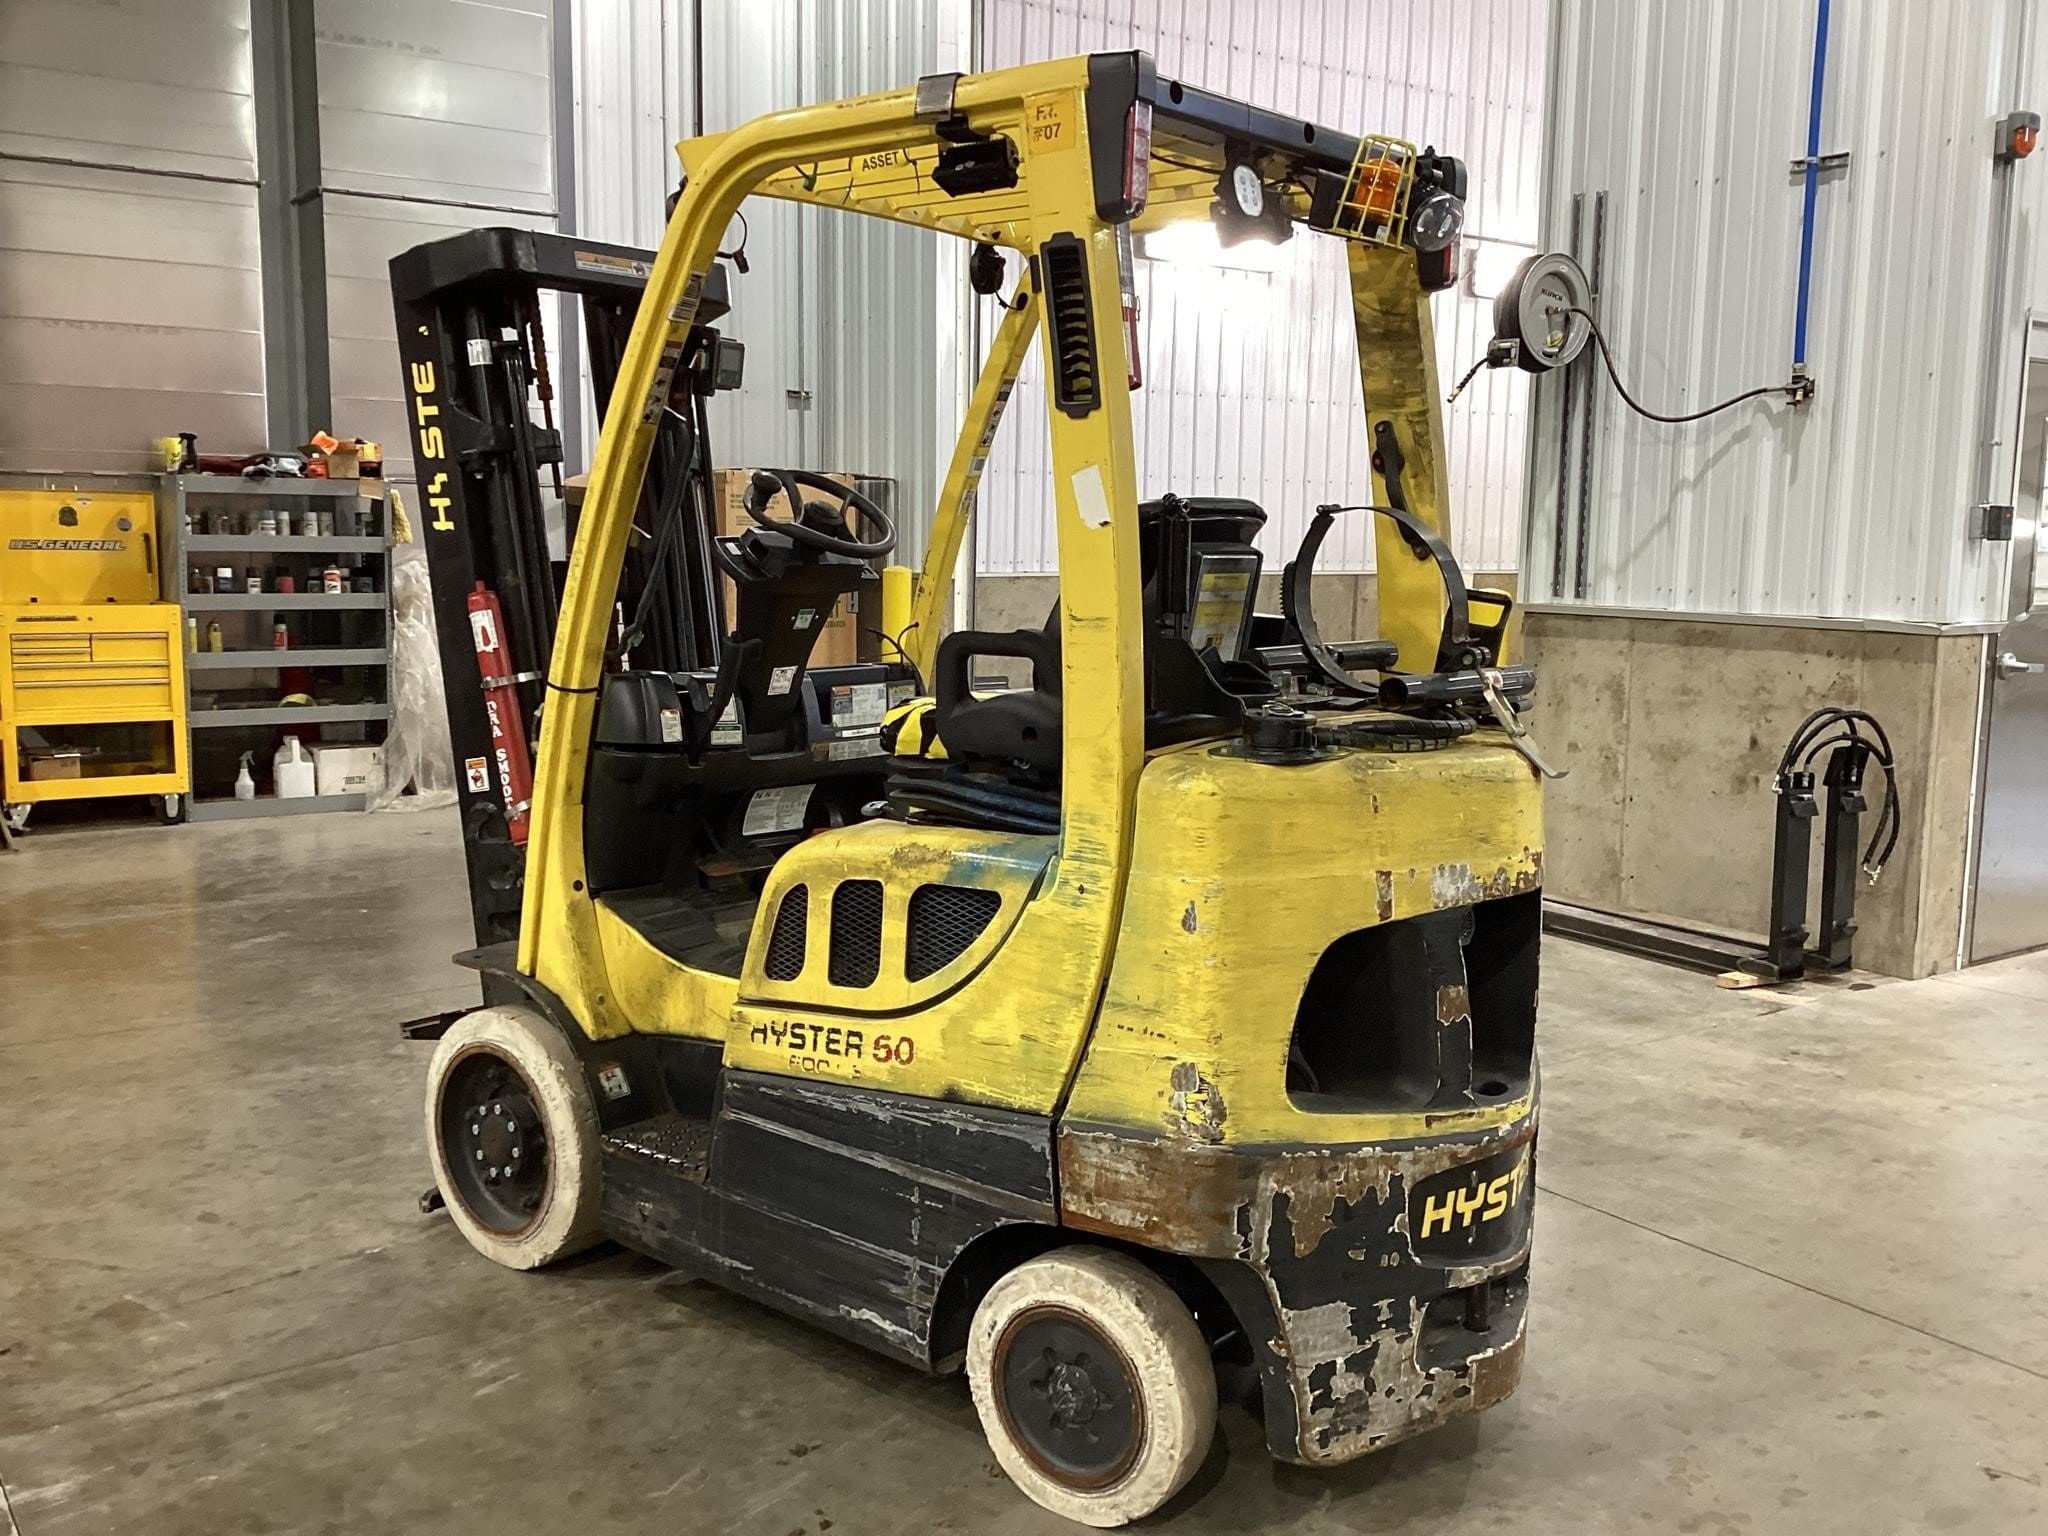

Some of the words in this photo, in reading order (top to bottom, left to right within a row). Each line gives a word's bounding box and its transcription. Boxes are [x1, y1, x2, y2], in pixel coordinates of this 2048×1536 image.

[861, 150, 899, 172] ASSET
[411, 326, 455, 531] HYSTE
[40, 540, 126, 551] GENERAL
[751, 1020, 864, 1059] HYSTER
[872, 1034, 915, 1066] 50
